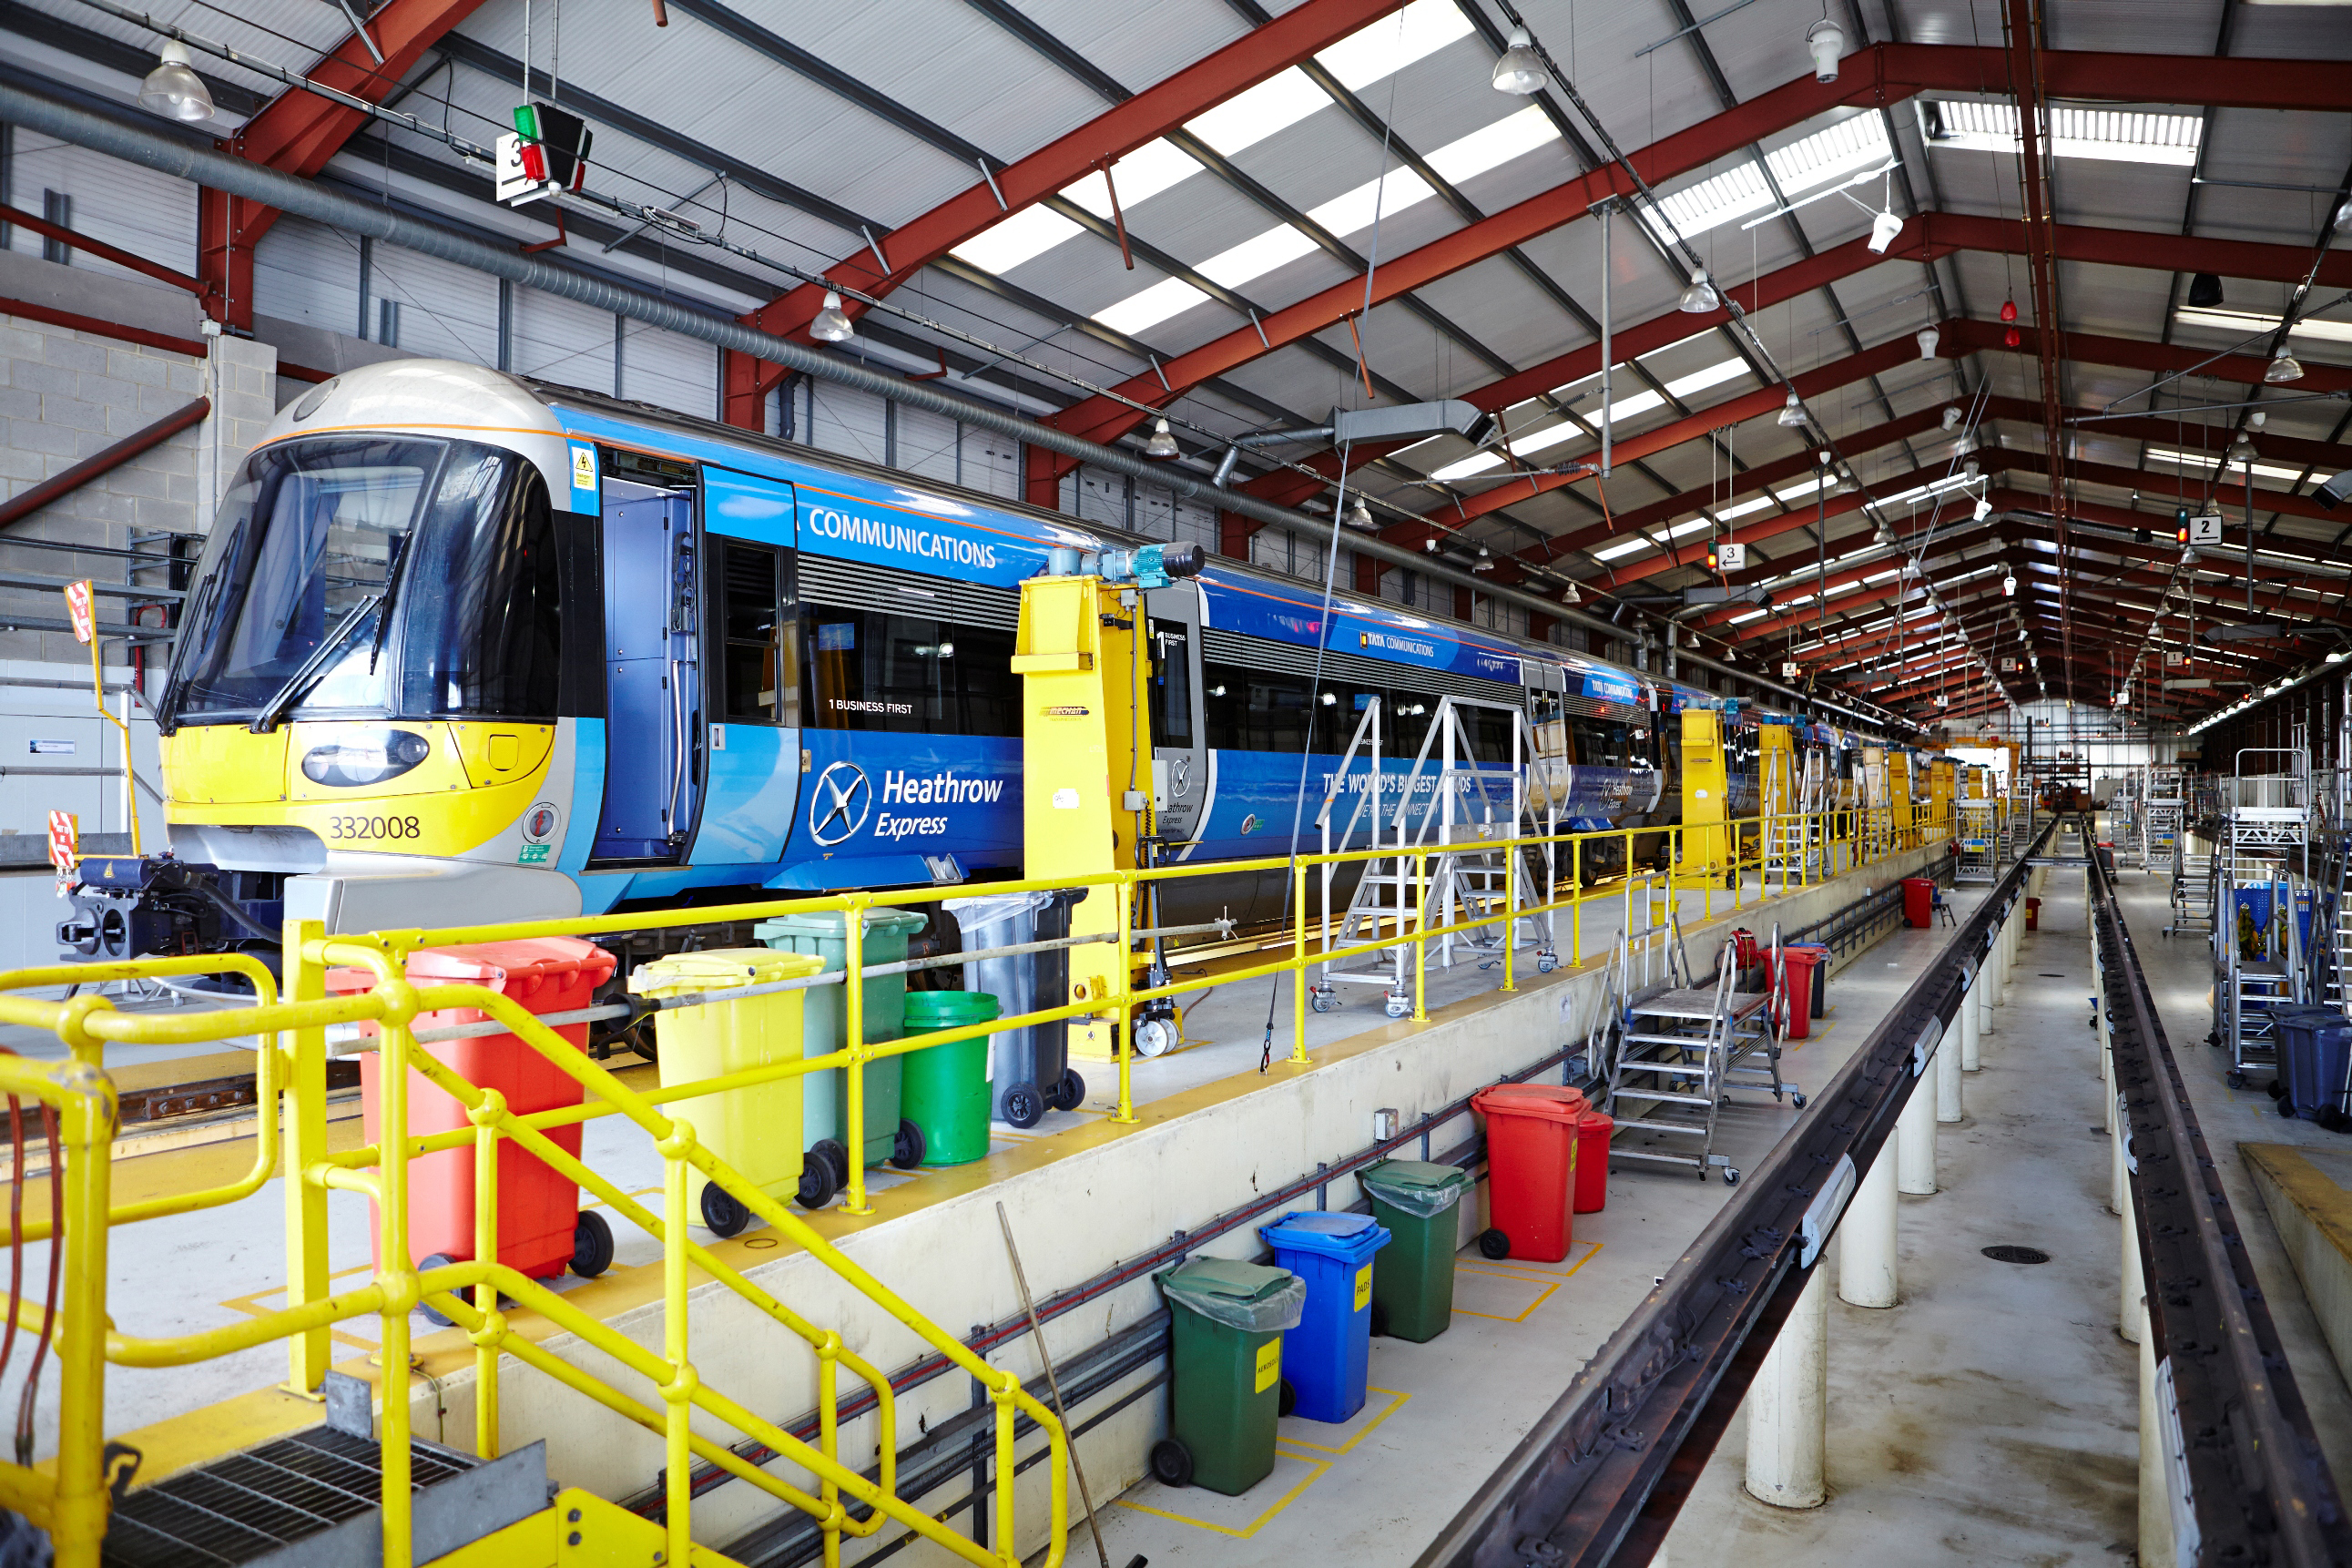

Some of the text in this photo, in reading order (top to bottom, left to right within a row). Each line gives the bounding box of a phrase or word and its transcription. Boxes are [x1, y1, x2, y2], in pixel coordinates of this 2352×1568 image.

[511, 138, 523, 168] 3
[2201, 520, 2210, 533] 2
[809, 508, 996, 569] COMMUNICATIONS
[1726, 546, 1735, 558] 3
[1156, 631, 1166, 659] 1
[1165, 633, 1186, 641] BUSINESS
[1368, 632, 1434, 657] TATA COMMUNICATIONS
[2173, 653, 2176, 661] 1
[829, 698, 913, 715] 1 BUSINESS FIRST
[882, 770, 1003, 804] Heathrow
[1349, 773, 1396, 793] WOD'S
[1398, 775, 1437, 793] BIGEST
[1380, 803, 1397, 817] THE
[330, 815, 421, 840] 332008
[874, 812, 949, 842] Express
[1162, 815, 1183, 826] Express
[1356, 1278, 1370, 1297] PADS
[1257, 1354, 1278, 1375] AEROSOLS
